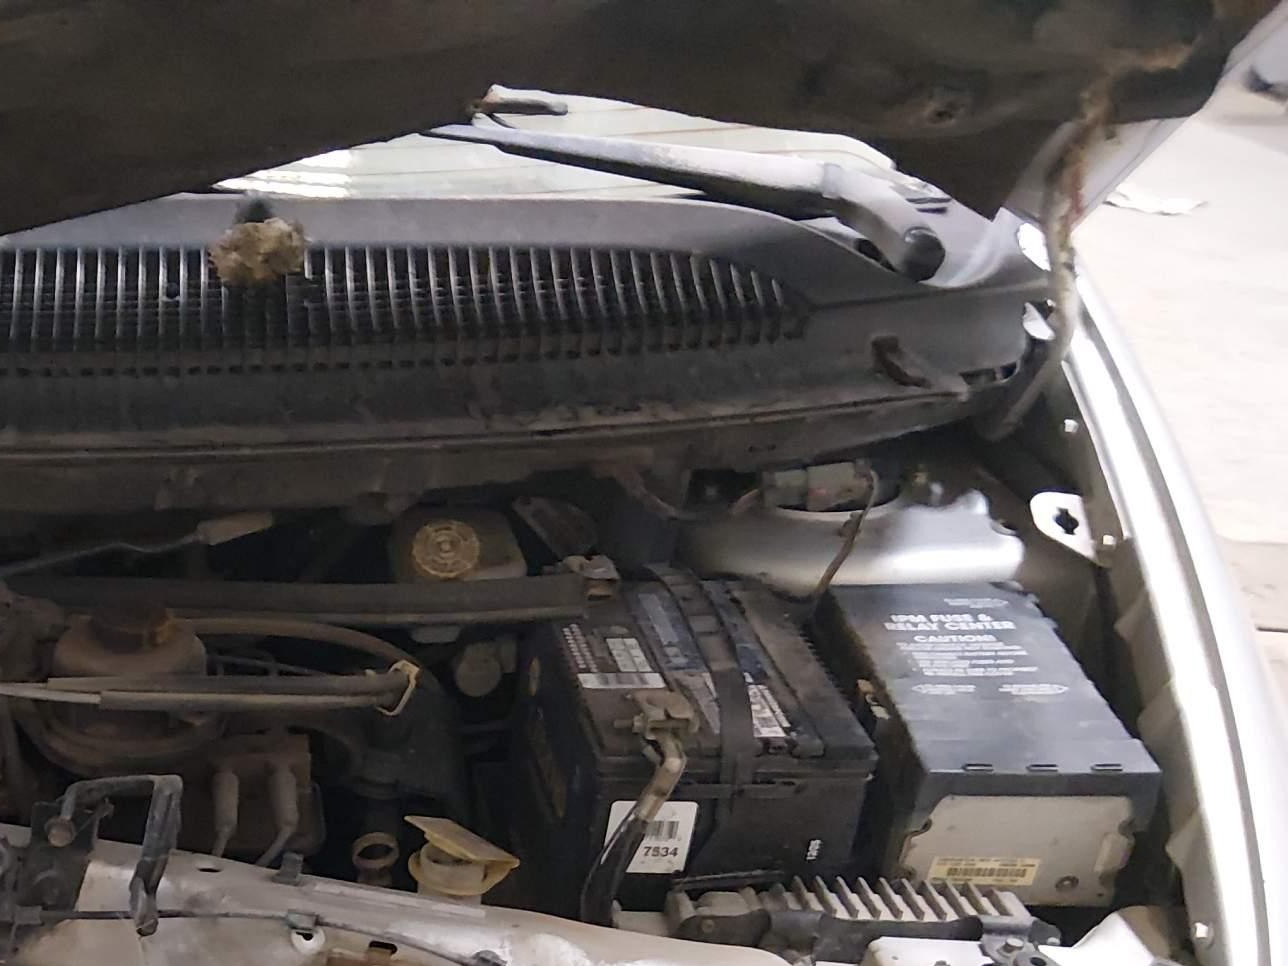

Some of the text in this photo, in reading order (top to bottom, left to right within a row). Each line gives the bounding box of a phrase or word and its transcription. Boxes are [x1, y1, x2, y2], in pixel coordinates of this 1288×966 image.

[929, 613, 973, 622] FUSE
[884, 621, 1016, 631] RELAY CENTER
